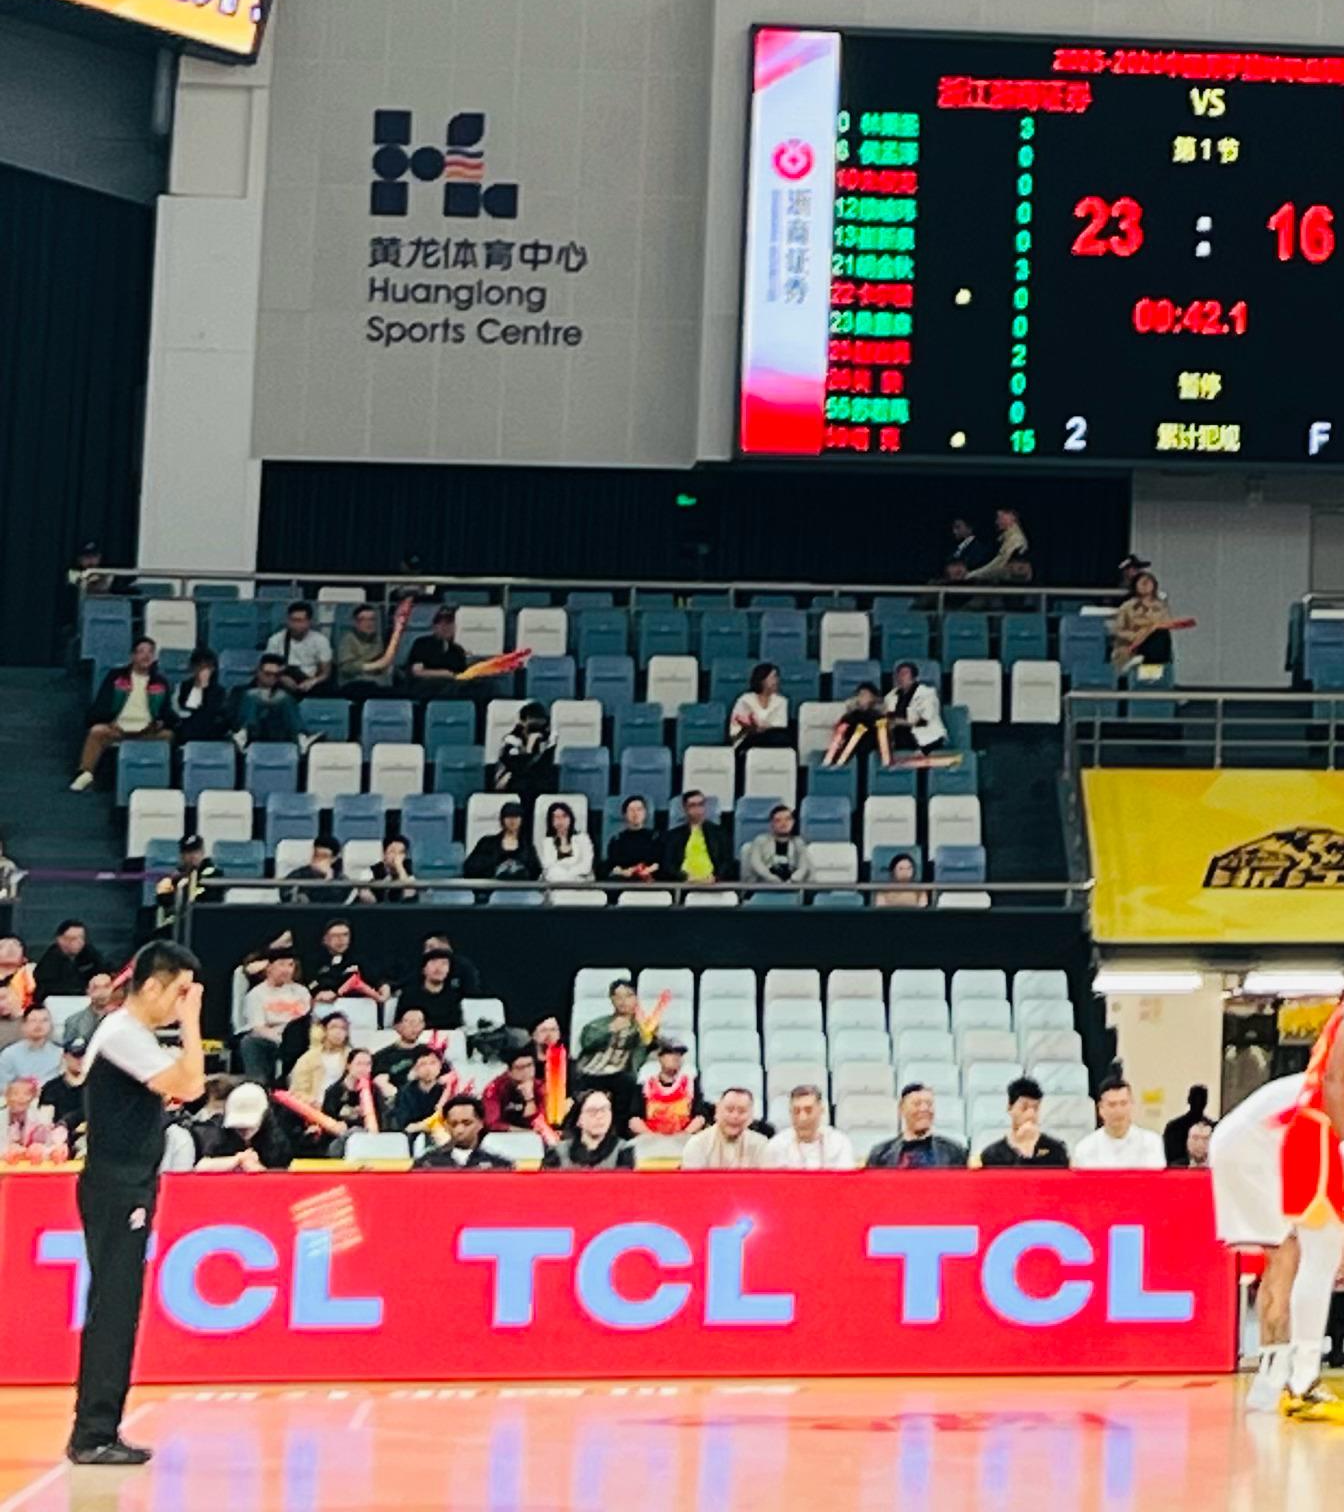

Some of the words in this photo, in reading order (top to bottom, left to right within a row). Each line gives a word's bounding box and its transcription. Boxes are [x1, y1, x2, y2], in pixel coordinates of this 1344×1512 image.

[1190, 87, 1226, 117] VS
[1071, 196, 1144, 256] 23
[1267, 202, 1334, 264] 16
[368, 237, 588, 272] 黄龙体育中心
[368, 277, 547, 313] Huanglong
[366, 316, 466, 347] Sports
[477, 318, 583, 346] Centre
[1132, 298, 1247, 335] 00:42.1
[1010, 344, 1027, 367] 2
[1064, 416, 1087, 451] 2
[1309, 422, 1332, 456] F
[458, 1222, 796, 1330] TCL
[868, 1219, 1195, 1326] TCL
